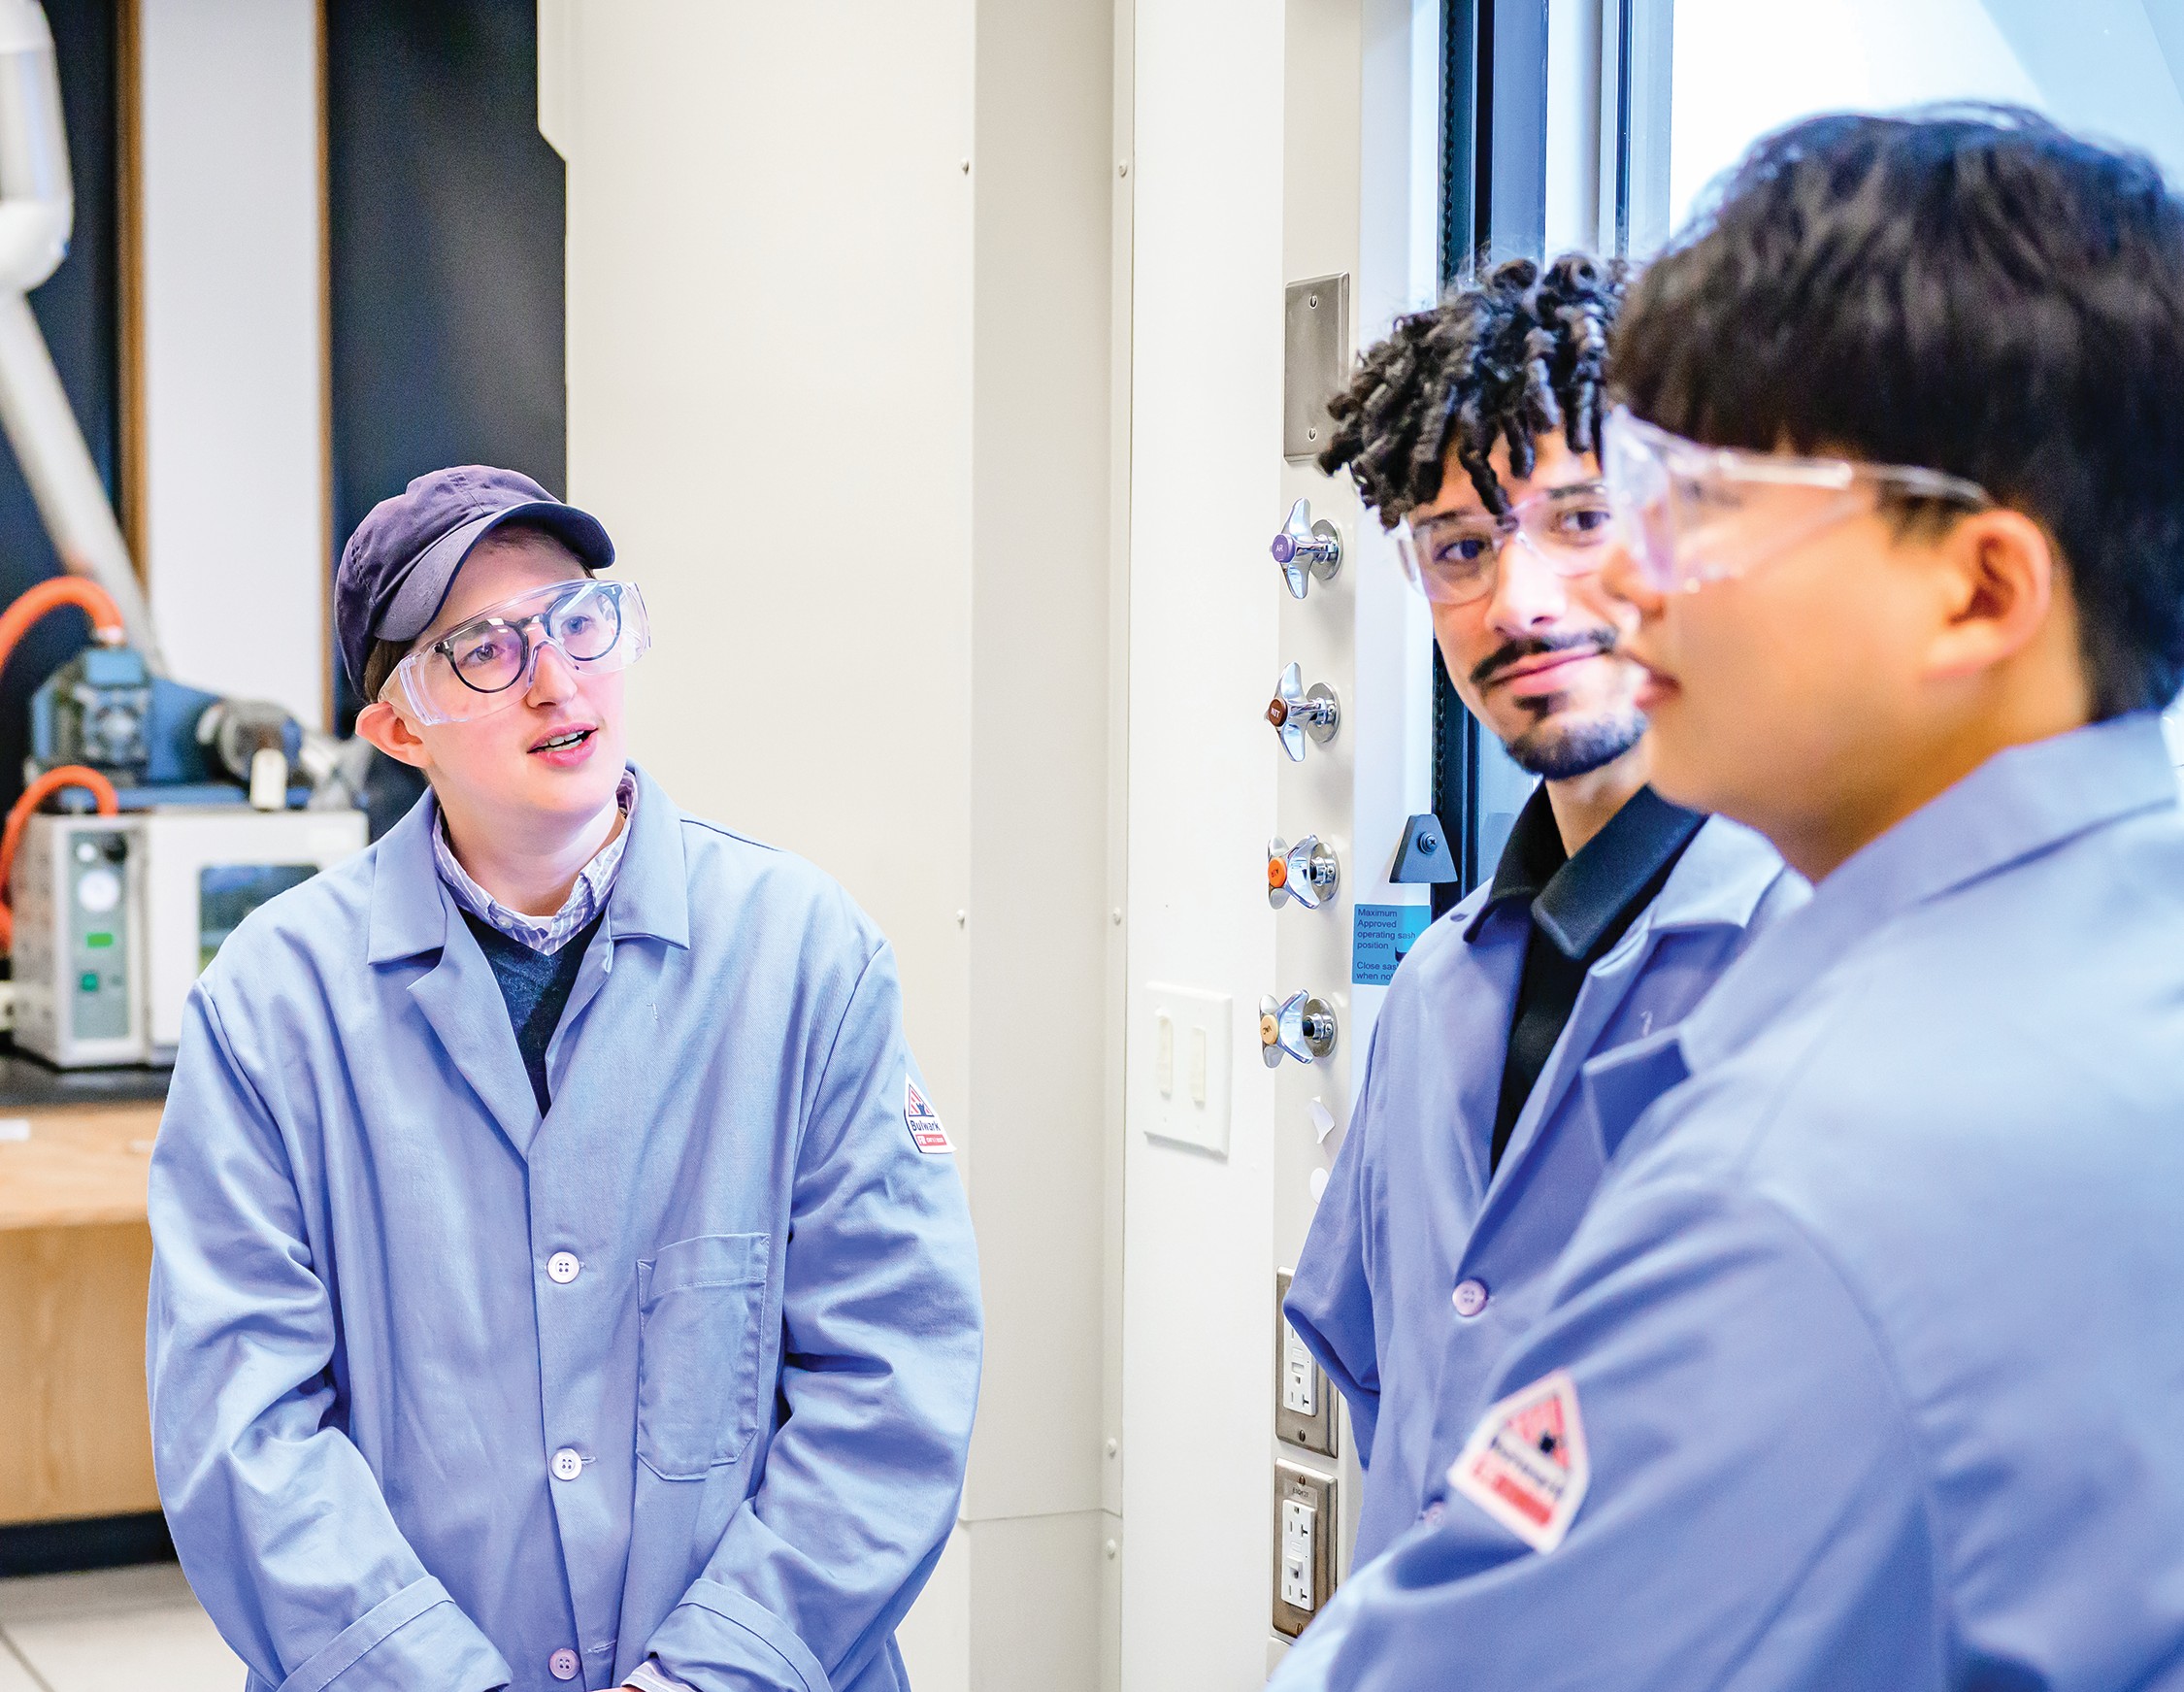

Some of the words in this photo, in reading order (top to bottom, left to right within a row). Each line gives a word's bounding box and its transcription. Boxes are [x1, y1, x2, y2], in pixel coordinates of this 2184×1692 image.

[1275, 544, 1284, 552] AR
[1357, 908, 1398, 917] Maximum
[1357, 919, 1397, 929] Approved
[1357, 931, 1396, 941] operating
[1356, 961, 1380, 971] Close
[1356, 972, 1378, 980] when
[910, 1119, 942, 1132] Bulwark
